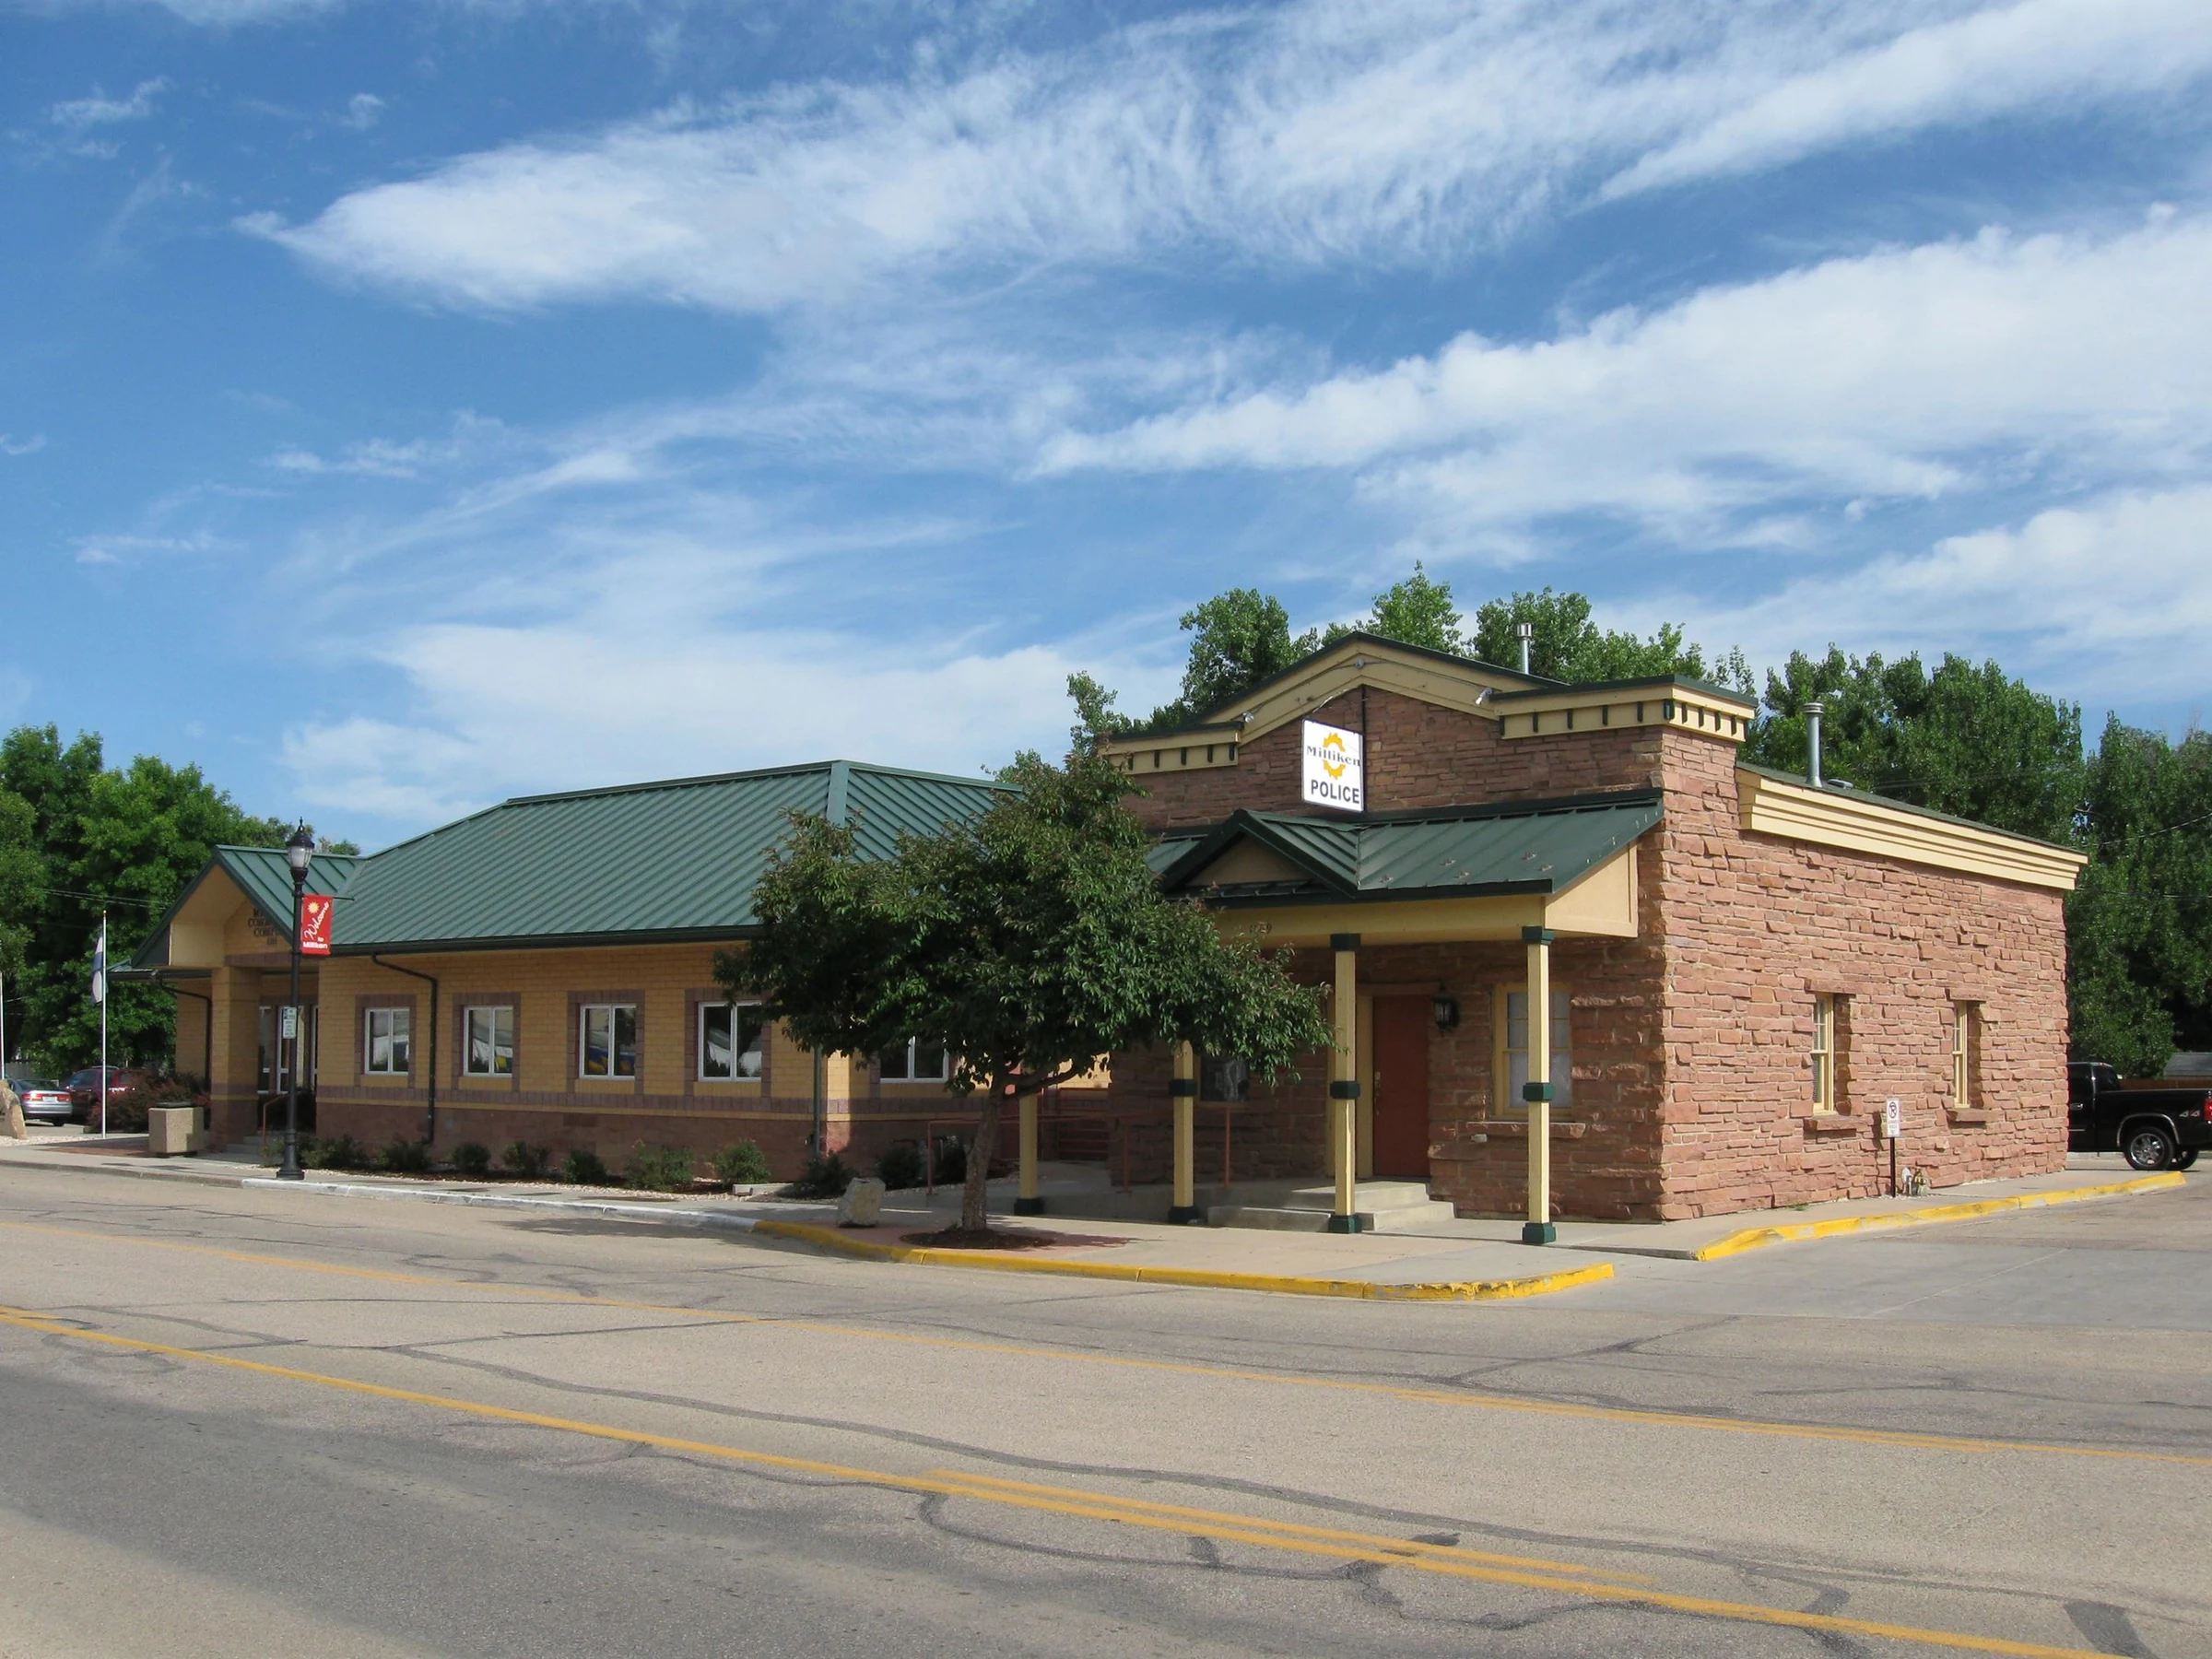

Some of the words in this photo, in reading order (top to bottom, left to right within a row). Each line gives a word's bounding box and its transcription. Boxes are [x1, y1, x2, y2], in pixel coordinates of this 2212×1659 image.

[1306, 746, 1360, 766] Milliken
[1311, 779, 1359, 804] POLICE
[304, 901, 329, 940] Welcome
